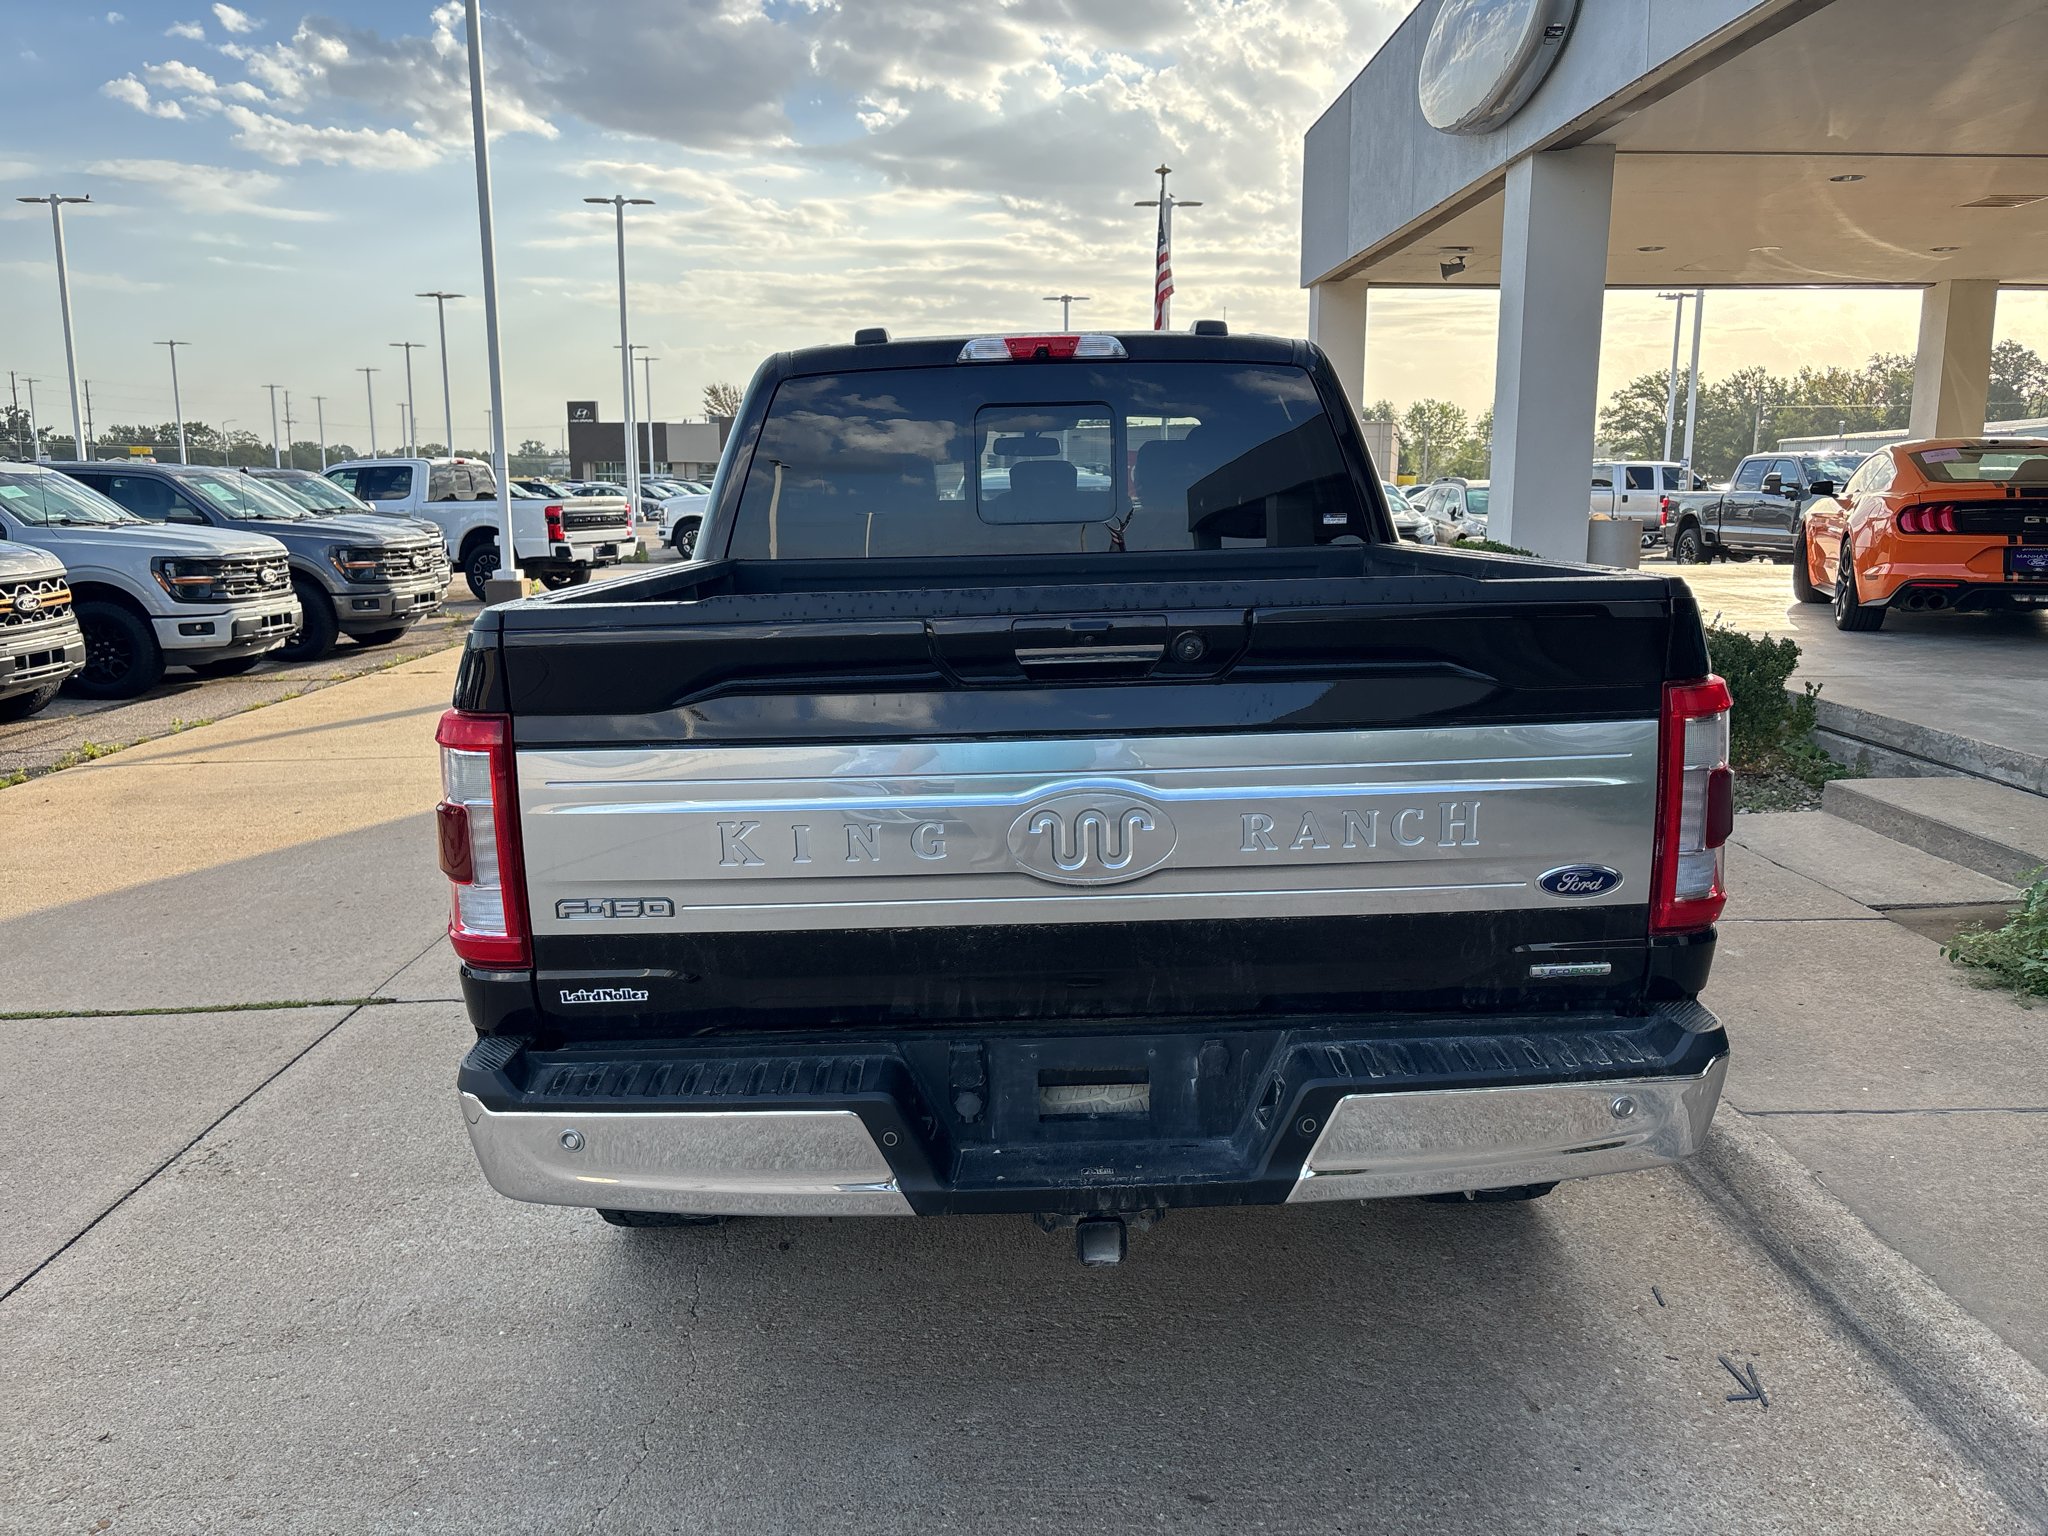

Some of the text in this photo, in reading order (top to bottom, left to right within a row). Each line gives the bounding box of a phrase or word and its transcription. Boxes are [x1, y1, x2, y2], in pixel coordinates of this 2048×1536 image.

[717, 801, 1481, 867] KING RANCH
[1557, 870, 1605, 892] Ford
[555, 897, 675, 919] F-150
